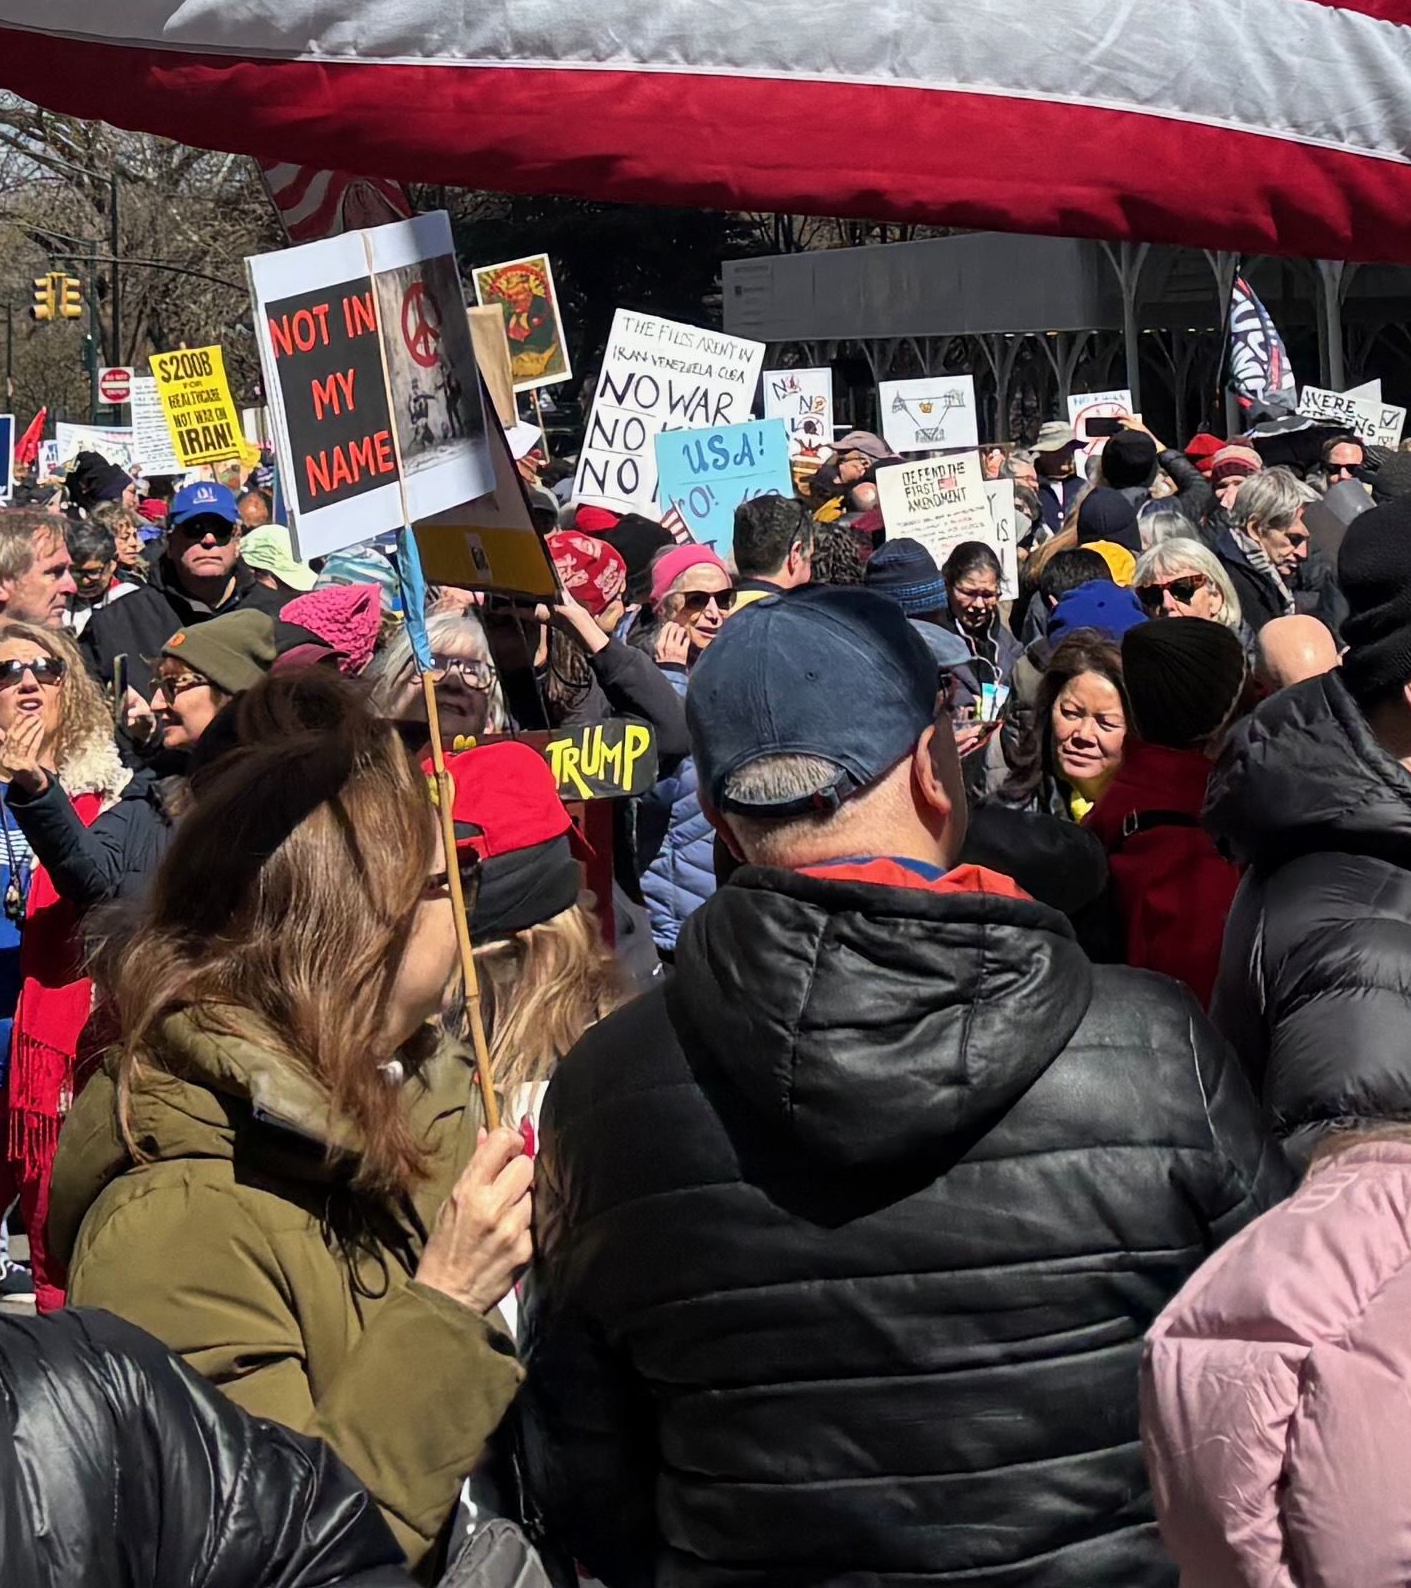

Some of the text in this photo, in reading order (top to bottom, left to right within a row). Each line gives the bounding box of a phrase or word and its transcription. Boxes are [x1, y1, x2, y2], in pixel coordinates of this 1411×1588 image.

[269, 291, 376, 359] NOT IN
[622, 316, 656, 338] THE
[158, 350, 213, 384] $200B
[311, 368, 356, 422] MY
[598, 369, 660, 410] NO
[668, 379, 734, 427] WAR
[176, 421, 237, 457] IRAN!
[588, 408, 647, 452] NO
[305, 430, 395, 497] NAME
[682, 430, 766, 475] USA!
[578, 457, 640, 496] NO
[902, 465, 946, 487] DEFEND
[904, 482, 936, 499] FIRST
[545, 724, 651, 800] TRUMP
